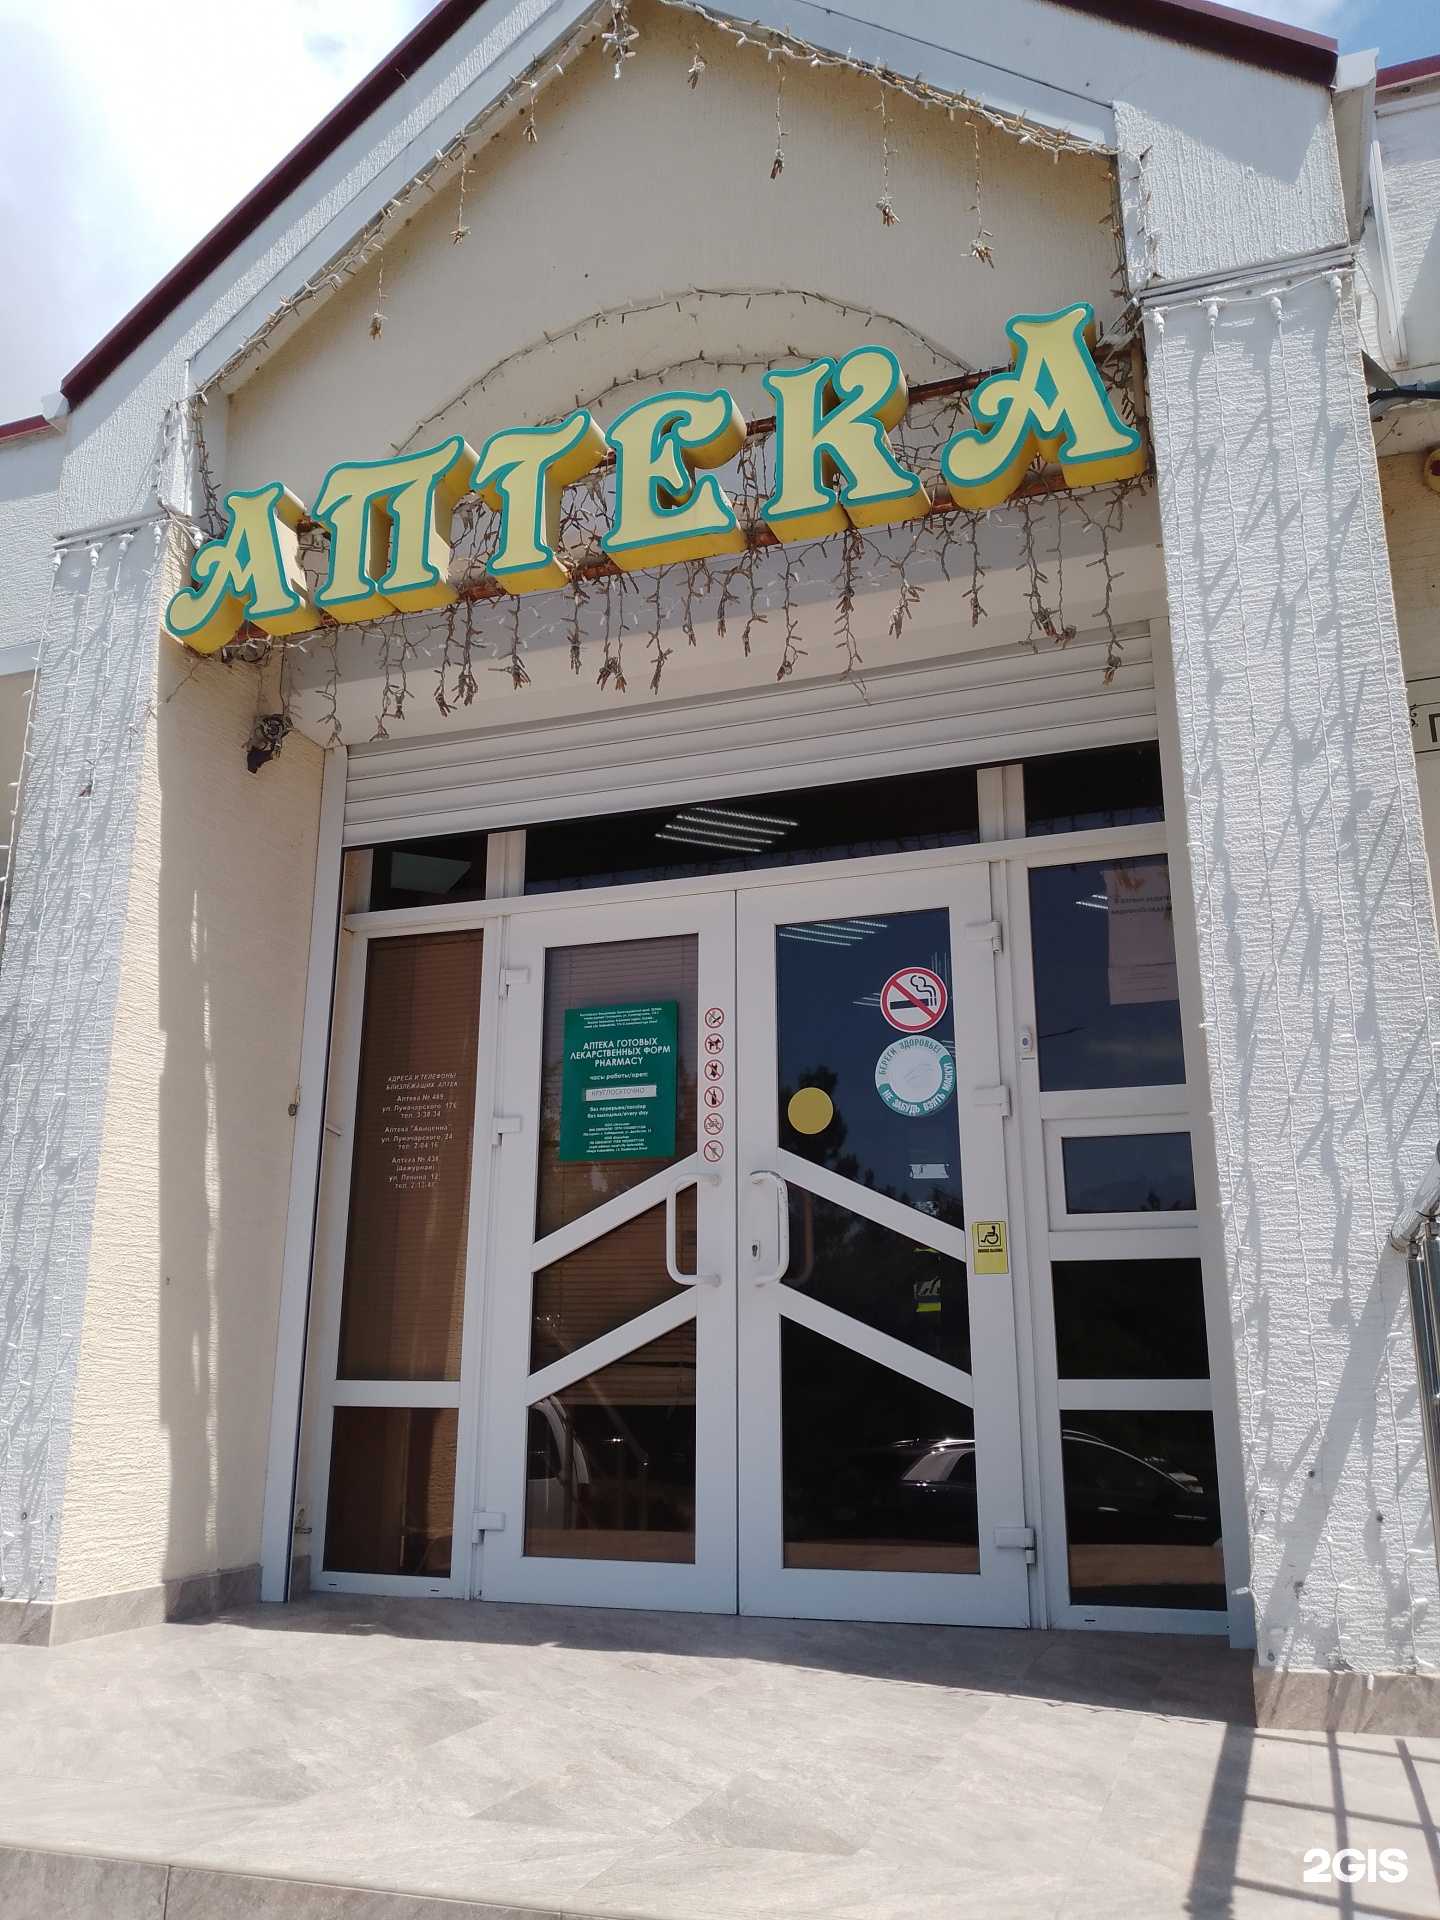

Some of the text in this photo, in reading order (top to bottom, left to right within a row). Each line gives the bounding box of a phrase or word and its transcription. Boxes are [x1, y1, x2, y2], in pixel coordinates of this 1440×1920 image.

[165, 302, 1144, 654] АПТЕКА
[583, 1037, 658, 1051] АПТЕКА ГОТОВЫХ
[570, 1045, 671, 1060] ЛЕКАРСТВЕННЫХ ФОРМ
[594, 1056, 644, 1067] PHARMACY
[388, 1074, 413, 1082] АДРЕСА
[421, 1072, 457, 1080] ТЕЛЕФОНЫ
[881, 1089, 894, 1102] НЕ
[892, 1098, 920, 1114] ЗАБУДЬ
[923, 1093, 946, 1111] ВЗЯТЬ
